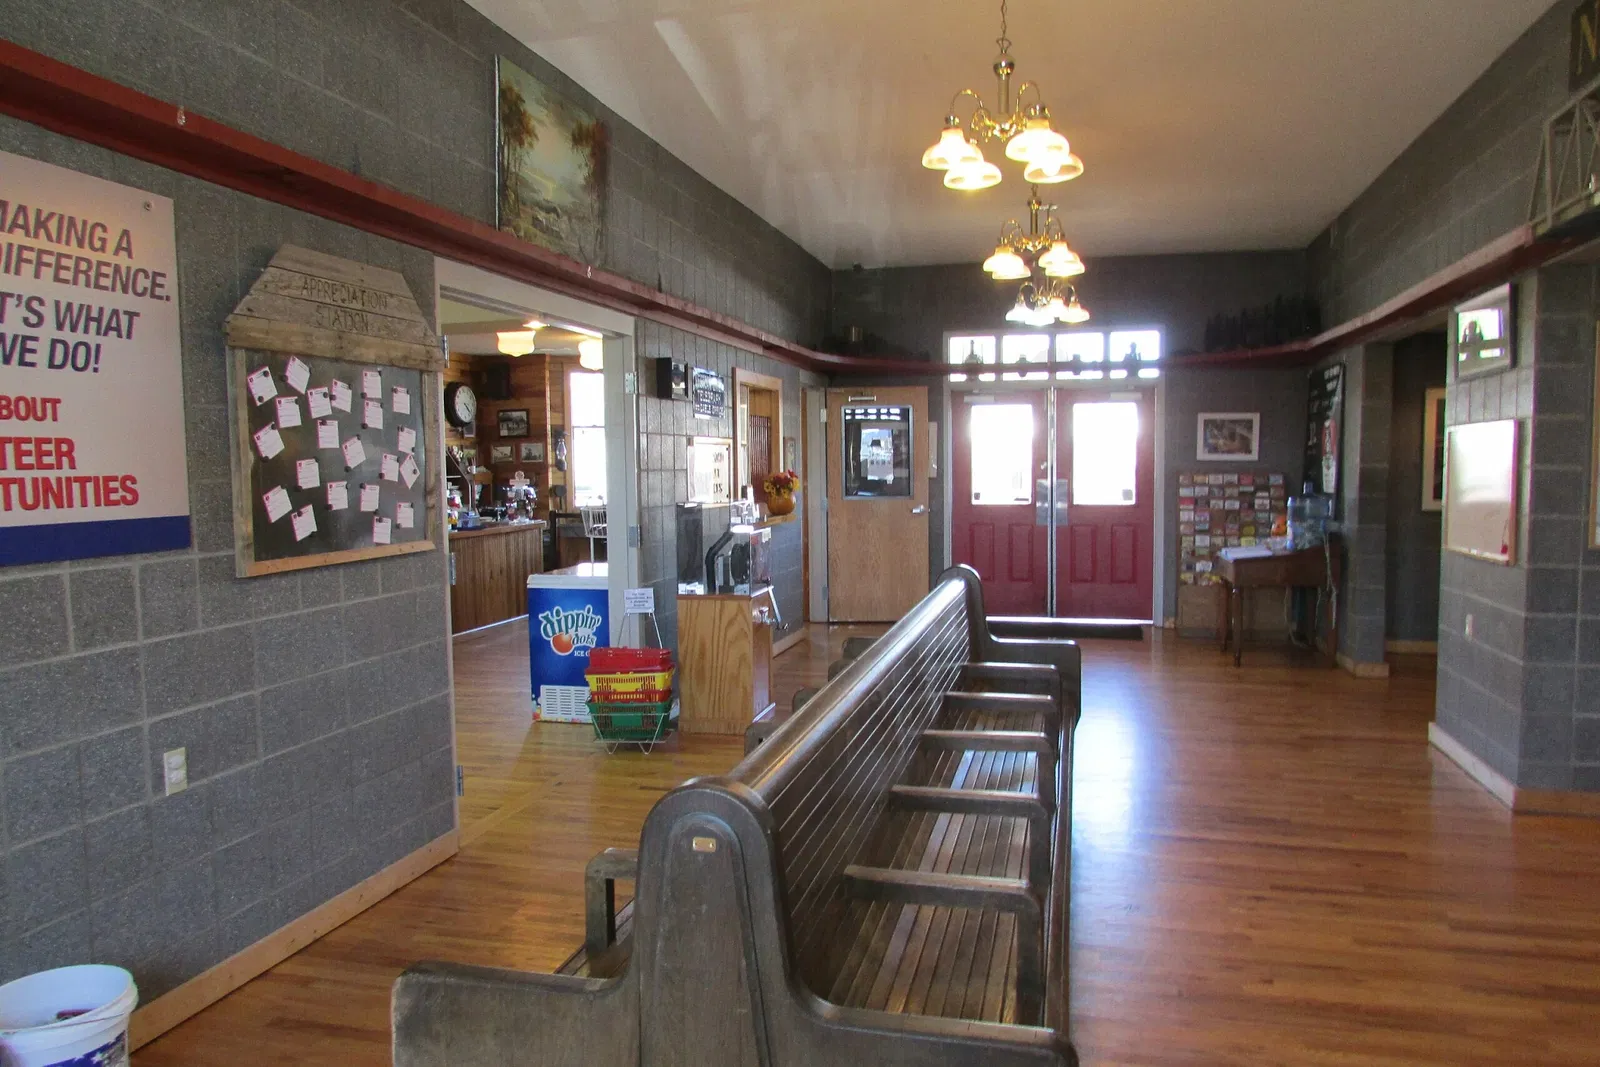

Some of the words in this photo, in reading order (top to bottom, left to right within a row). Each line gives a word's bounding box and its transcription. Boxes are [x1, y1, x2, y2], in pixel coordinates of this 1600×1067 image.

[113, 228, 133, 259] A
[0, 242, 171, 302] IFFERENCE.
[300, 277, 388, 310] APPRECIATION
[54, 299, 140, 340] WHAT
[316, 304, 369, 333] STATION
[48, 338, 102, 373] DO!
[571, 632, 597, 647] dots
